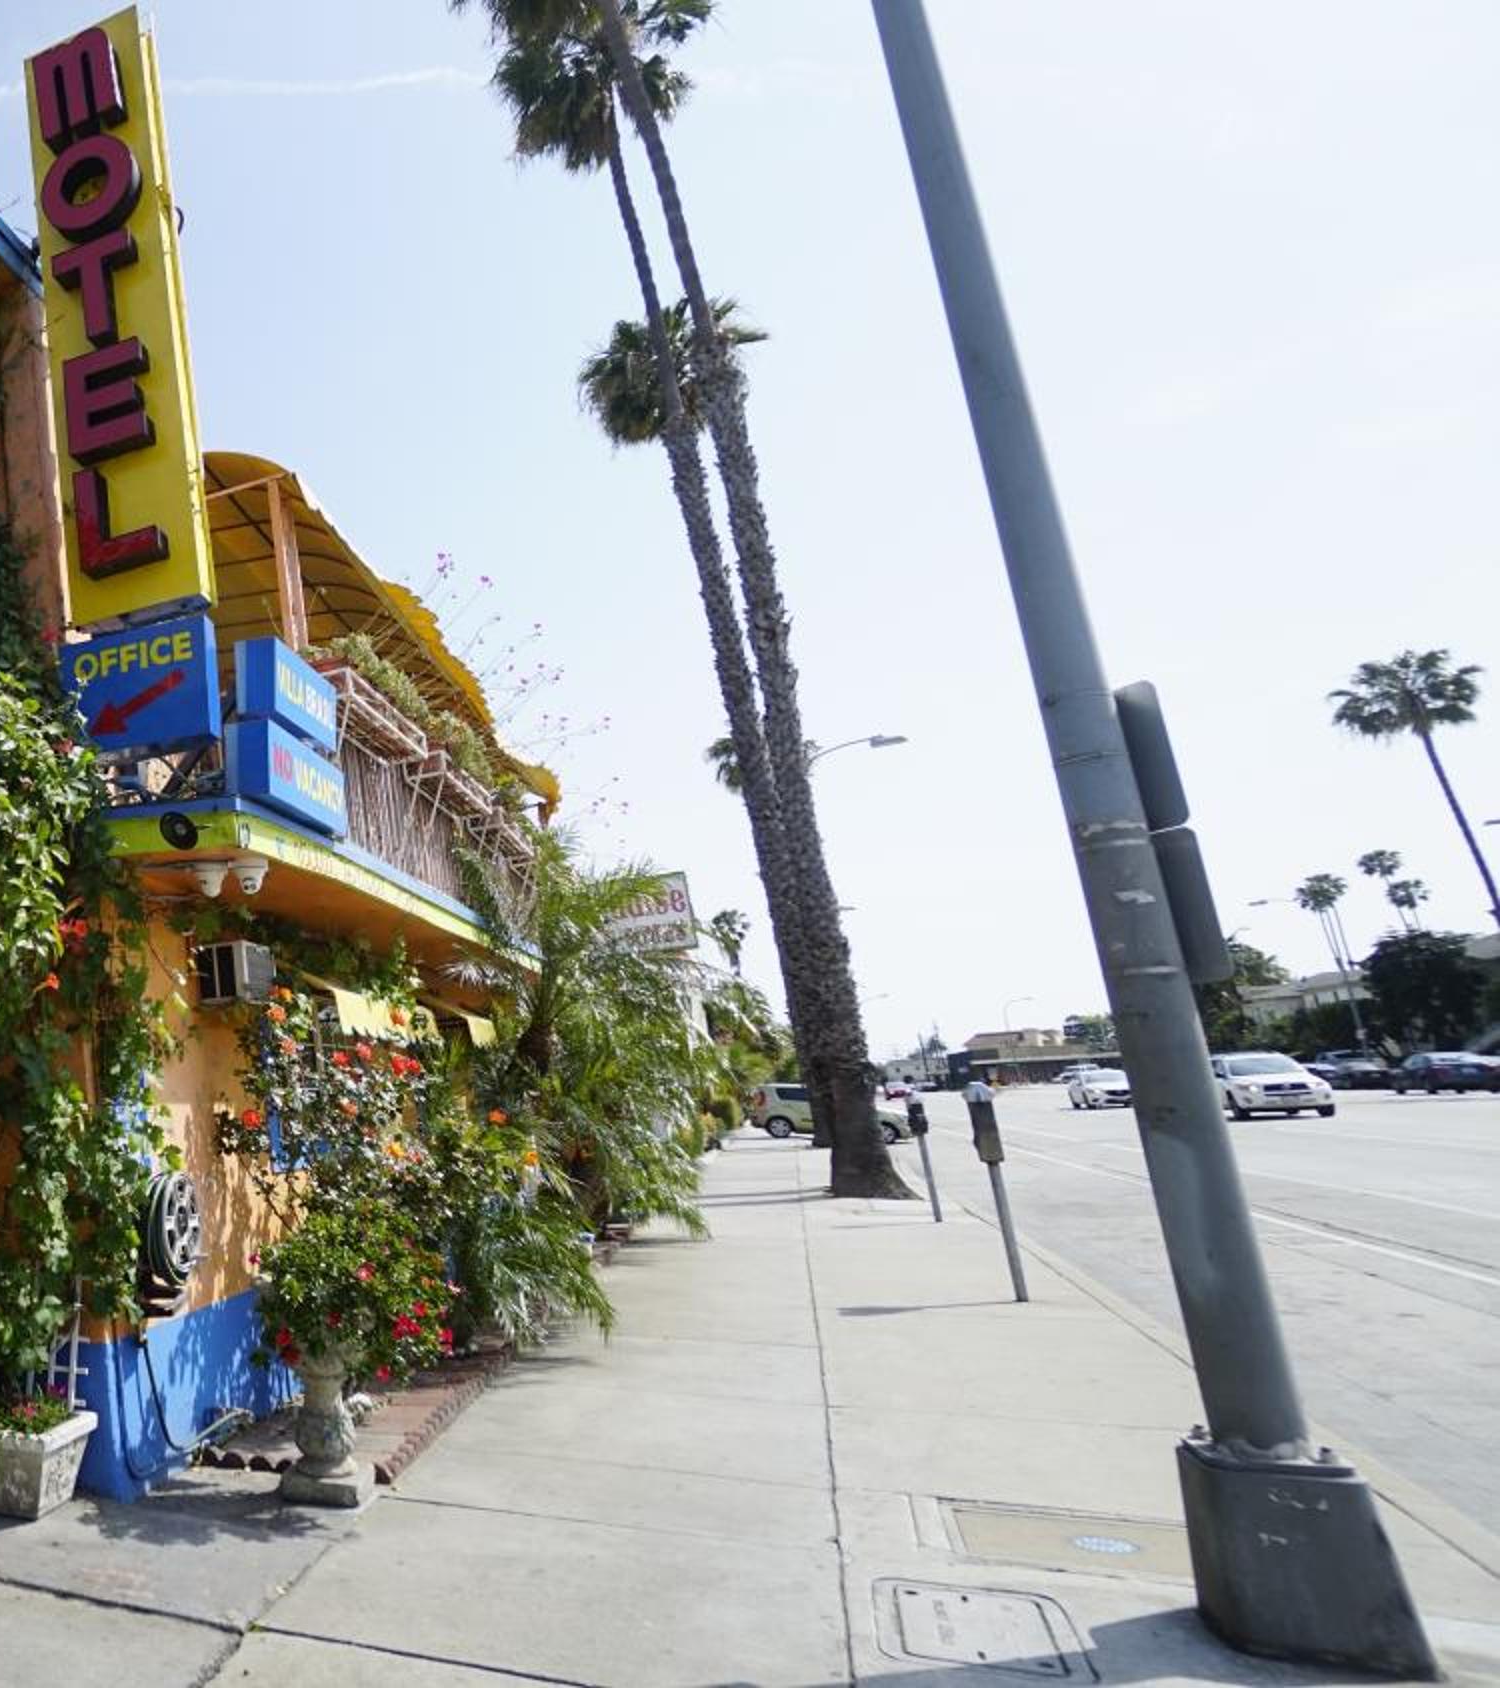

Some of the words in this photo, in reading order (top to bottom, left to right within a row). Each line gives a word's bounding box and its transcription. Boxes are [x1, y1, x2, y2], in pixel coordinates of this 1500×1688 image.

[31, 26, 170, 580] MOTEL
[73, 631, 193, 681] OFFICE
[273, 745, 293, 784] NO
[294, 756, 347, 814] VACANCY
